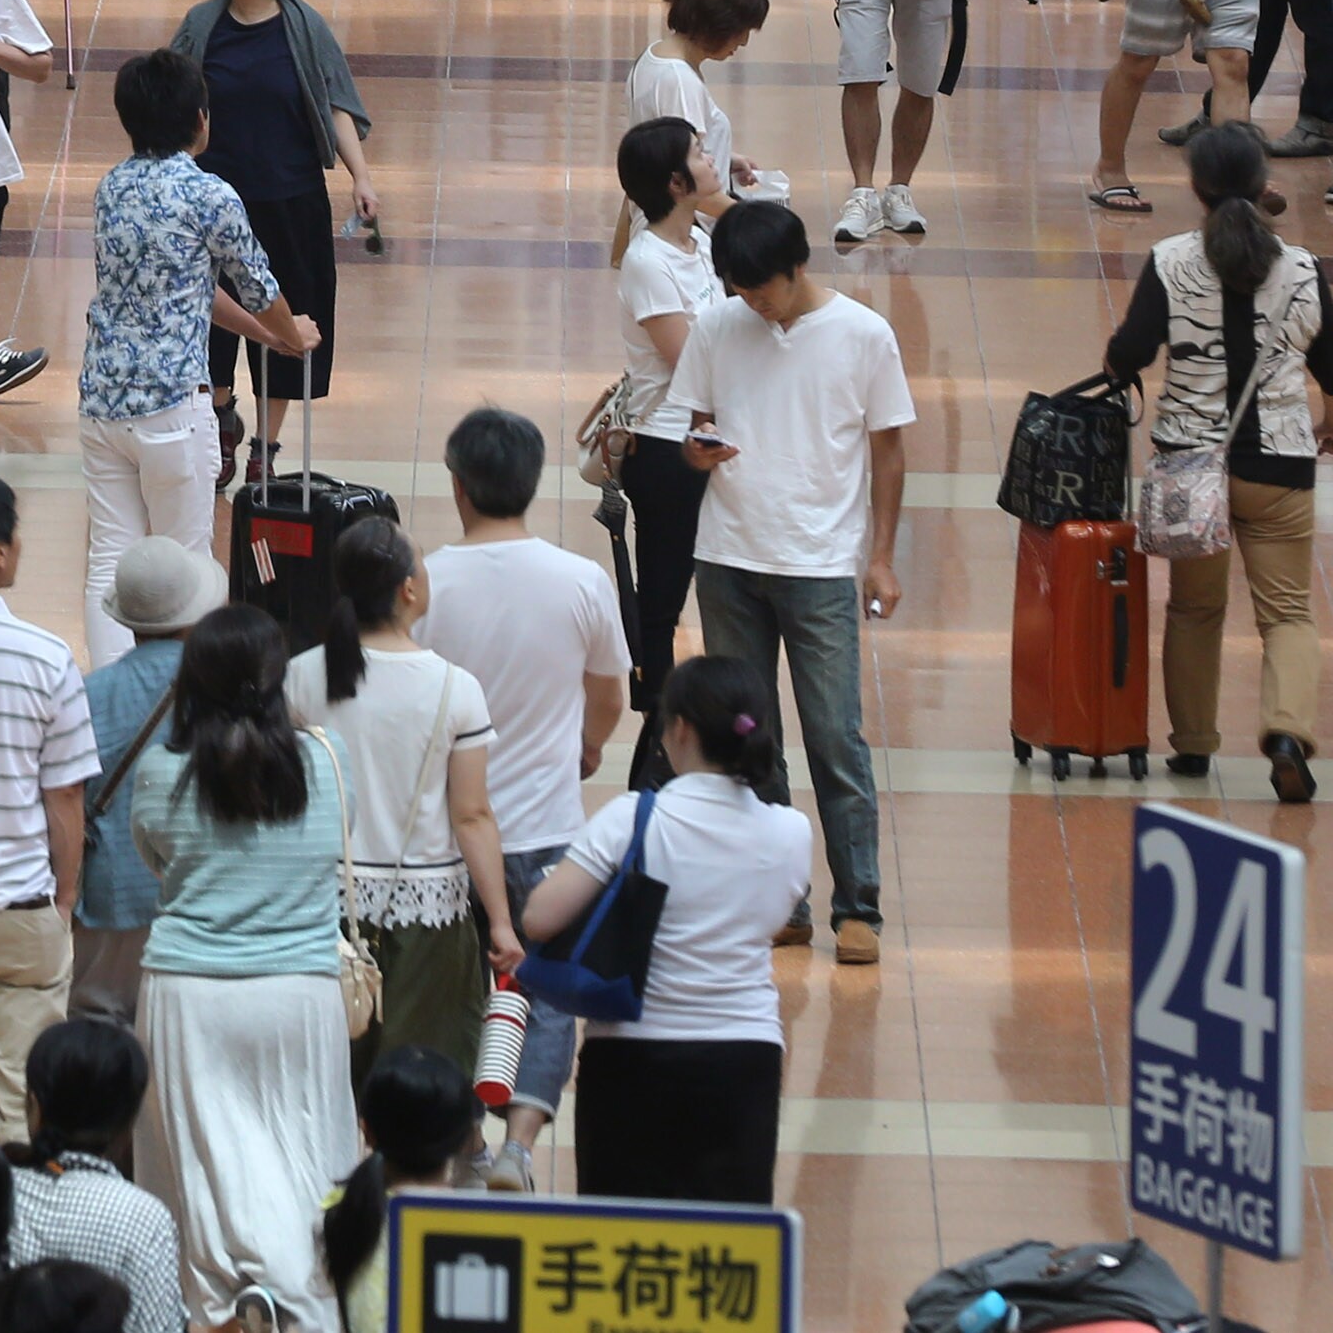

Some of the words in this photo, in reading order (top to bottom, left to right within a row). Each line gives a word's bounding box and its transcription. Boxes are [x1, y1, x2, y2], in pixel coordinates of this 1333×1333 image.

[1135, 826, 1277, 1083] 24
[1135, 1060, 1275, 1184] 手荷物
[1135, 1150, 1275, 1250] BAGGAGE
[536, 1238, 760, 1324] 手荷物
